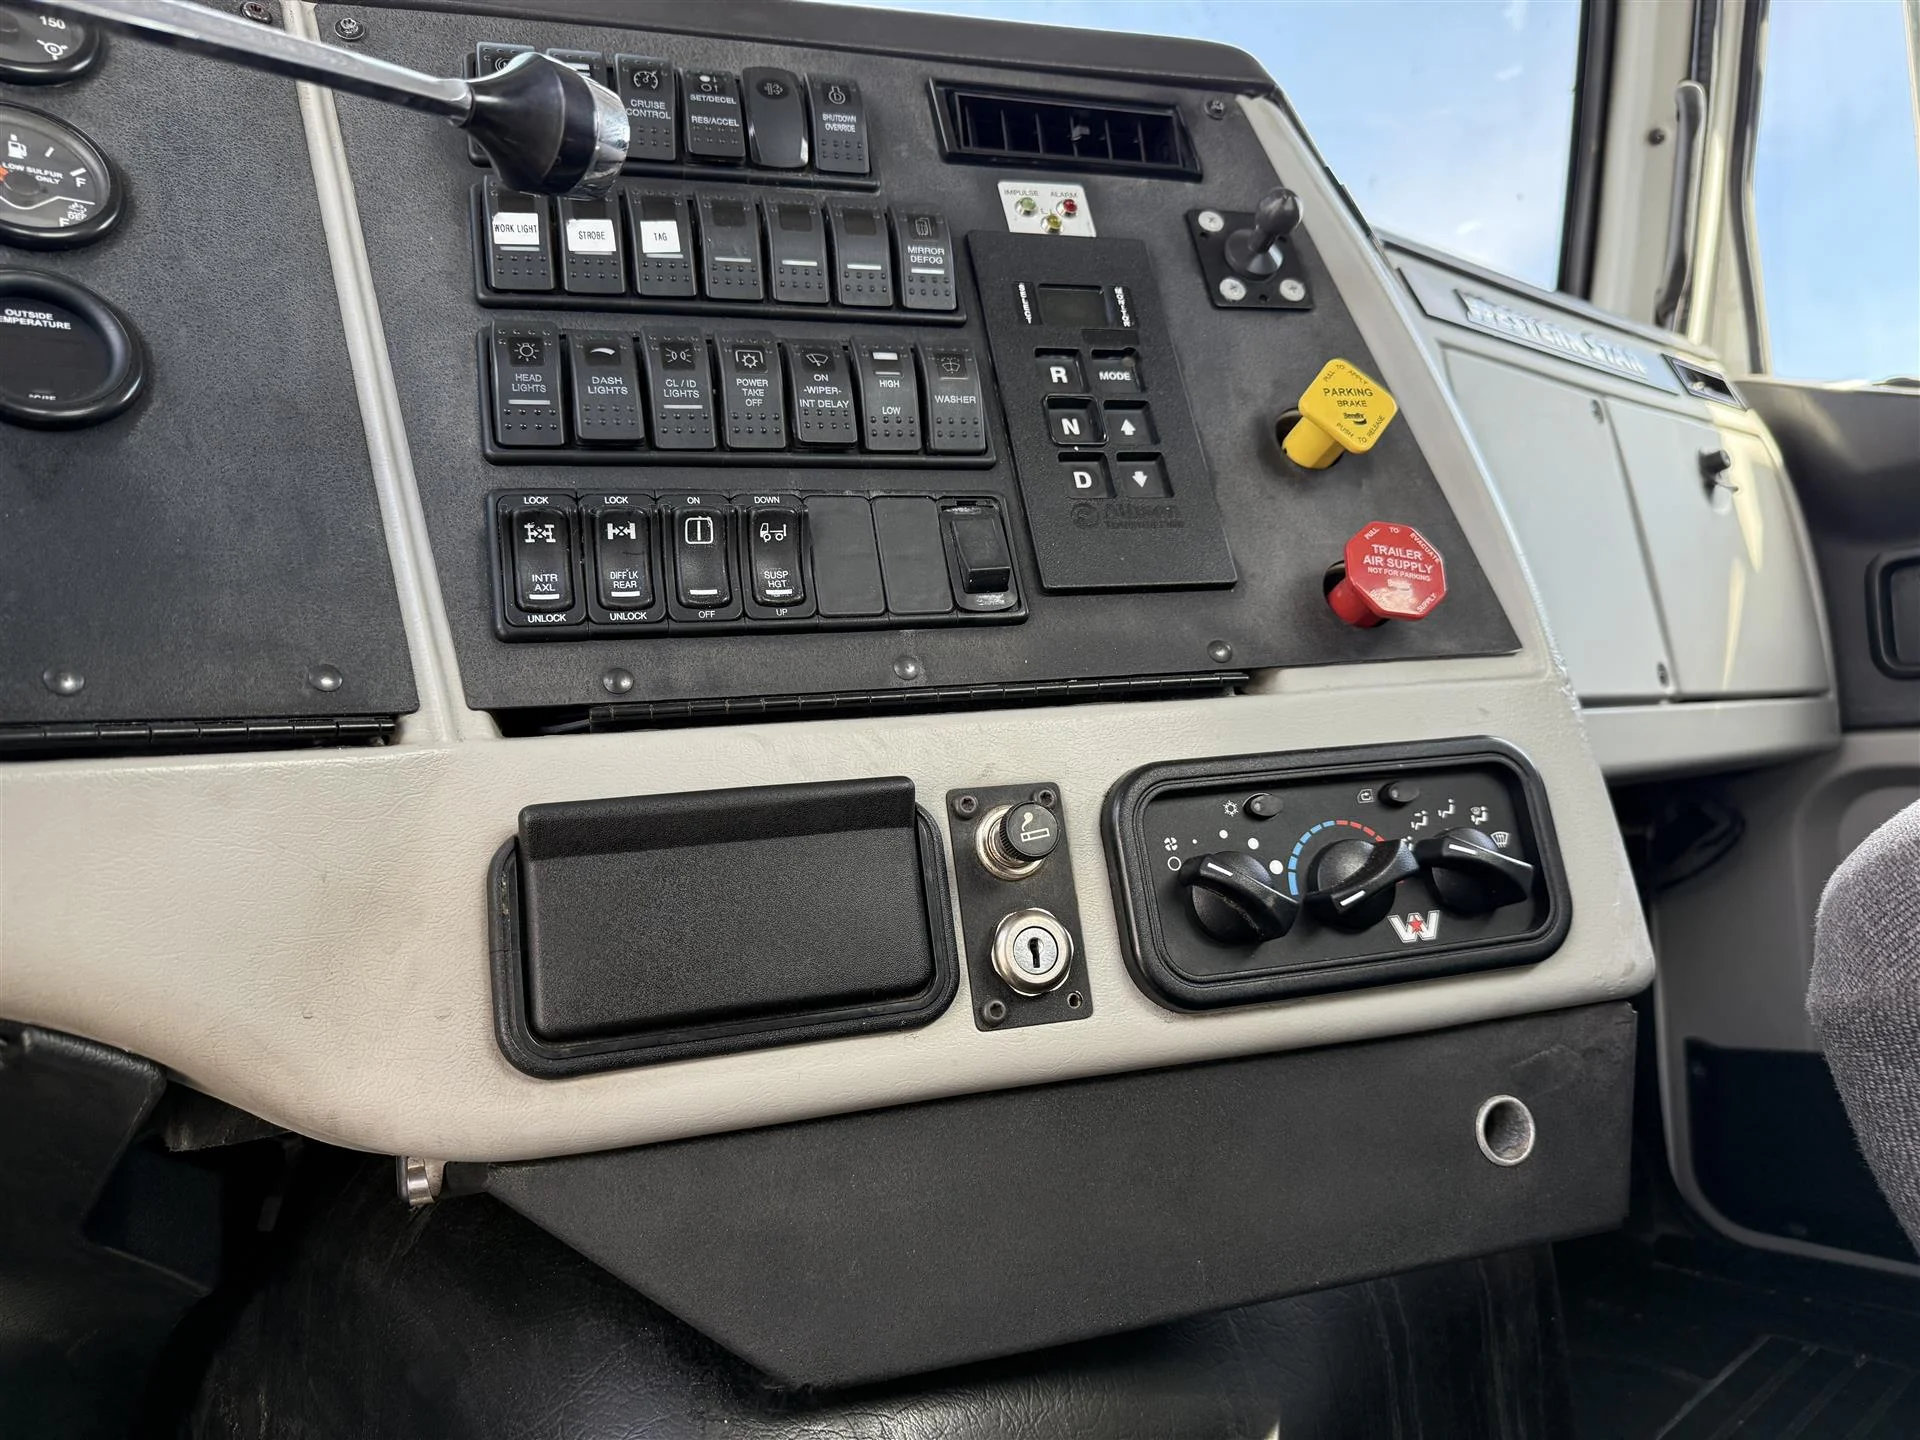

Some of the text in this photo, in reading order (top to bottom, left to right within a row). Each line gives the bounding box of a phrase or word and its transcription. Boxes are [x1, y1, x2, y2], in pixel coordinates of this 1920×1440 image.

[39, 15, 66, 30] 150
[690, 93, 737, 105] SET/DECEL
[629, 98, 667, 111] CRUISE
[625, 107, 672, 120] CONTROL
[822, 112, 858, 124] SHUTDOWN
[691, 115, 740, 127] RES/ACCEL
[824, 122, 857, 134] OVERRIDE
[2, 162, 64, 179] LOW SULFUR
[34, 175, 61, 185] ONLY
[75, 177, 87, 188] F
[1003, 189, 1040, 197] IMPULSE
[59, 217, 70, 227] F
[494, 223, 538, 234] WORK LIGHT
[578, 230, 606, 241] STROBE
[653, 232, 668, 242] TAG
[907, 245, 945, 256] MIRROR
[910, 255, 944, 265] DEFOG
[4, 308, 53, 321] OUTSIDE
[0, 315, 71, 330] EMPERATURE
[515, 373, 542, 383] HEAD
[813, 374, 829, 383] ON
[1049, 366, 1069, 384] R
[1099, 371, 1132, 382] MODE
[591, 376, 623, 386] DASH
[665, 378, 680, 389] CL
[736, 378, 769, 388] POWER
[879, 379, 901, 389] HIGH
[511, 383, 547, 393] LIGHTS
[587, 386, 629, 396] LIGHTS
[742, 388, 765, 398] TAKE
[803, 386, 842, 396] -WIPER-
[1322, 387, 1374, 397] PARKING
[663, 389, 700, 399] LIGHTS
[745, 398, 763, 407] OFF
[800, 398, 850, 409] INT DELAY
[934, 394, 977, 405] WASHER
[1336, 399, 1368, 408] BRAKE
[881, 406, 901, 416] LOW
[1061, 418, 1081, 435] N
[1336, 422, 1355, 438] PUSH
[1357, 436, 1367, 444] TO
[1073, 471, 1092, 489] D
[524, 496, 550, 505] LOCK
[604, 496, 629, 505] LOCK
[686, 496, 701, 505] ON
[753, 496, 781, 505] DOWN
[1364, 526, 1441, 564] PULL TO EVACUATE
[1371, 544, 1422, 561] TRAILER
[1362, 554, 1434, 575] AIR SUPPLY
[531, 573, 559, 583] INTR
[763, 570, 789, 580] SUSP
[1367, 566, 1432, 582] NOT FOR PARKING
[534, 582, 556, 592] AXL
[613, 580, 638, 589] REAR
[767, 579, 788, 589] HGT
[1416, 592, 1437, 614] SUPPLY
[609, 611, 648, 622] UNLOCK
[698, 610, 716, 619] OFF
[775, 608, 788, 617] UP
[527, 613, 567, 624] UNLOCK
